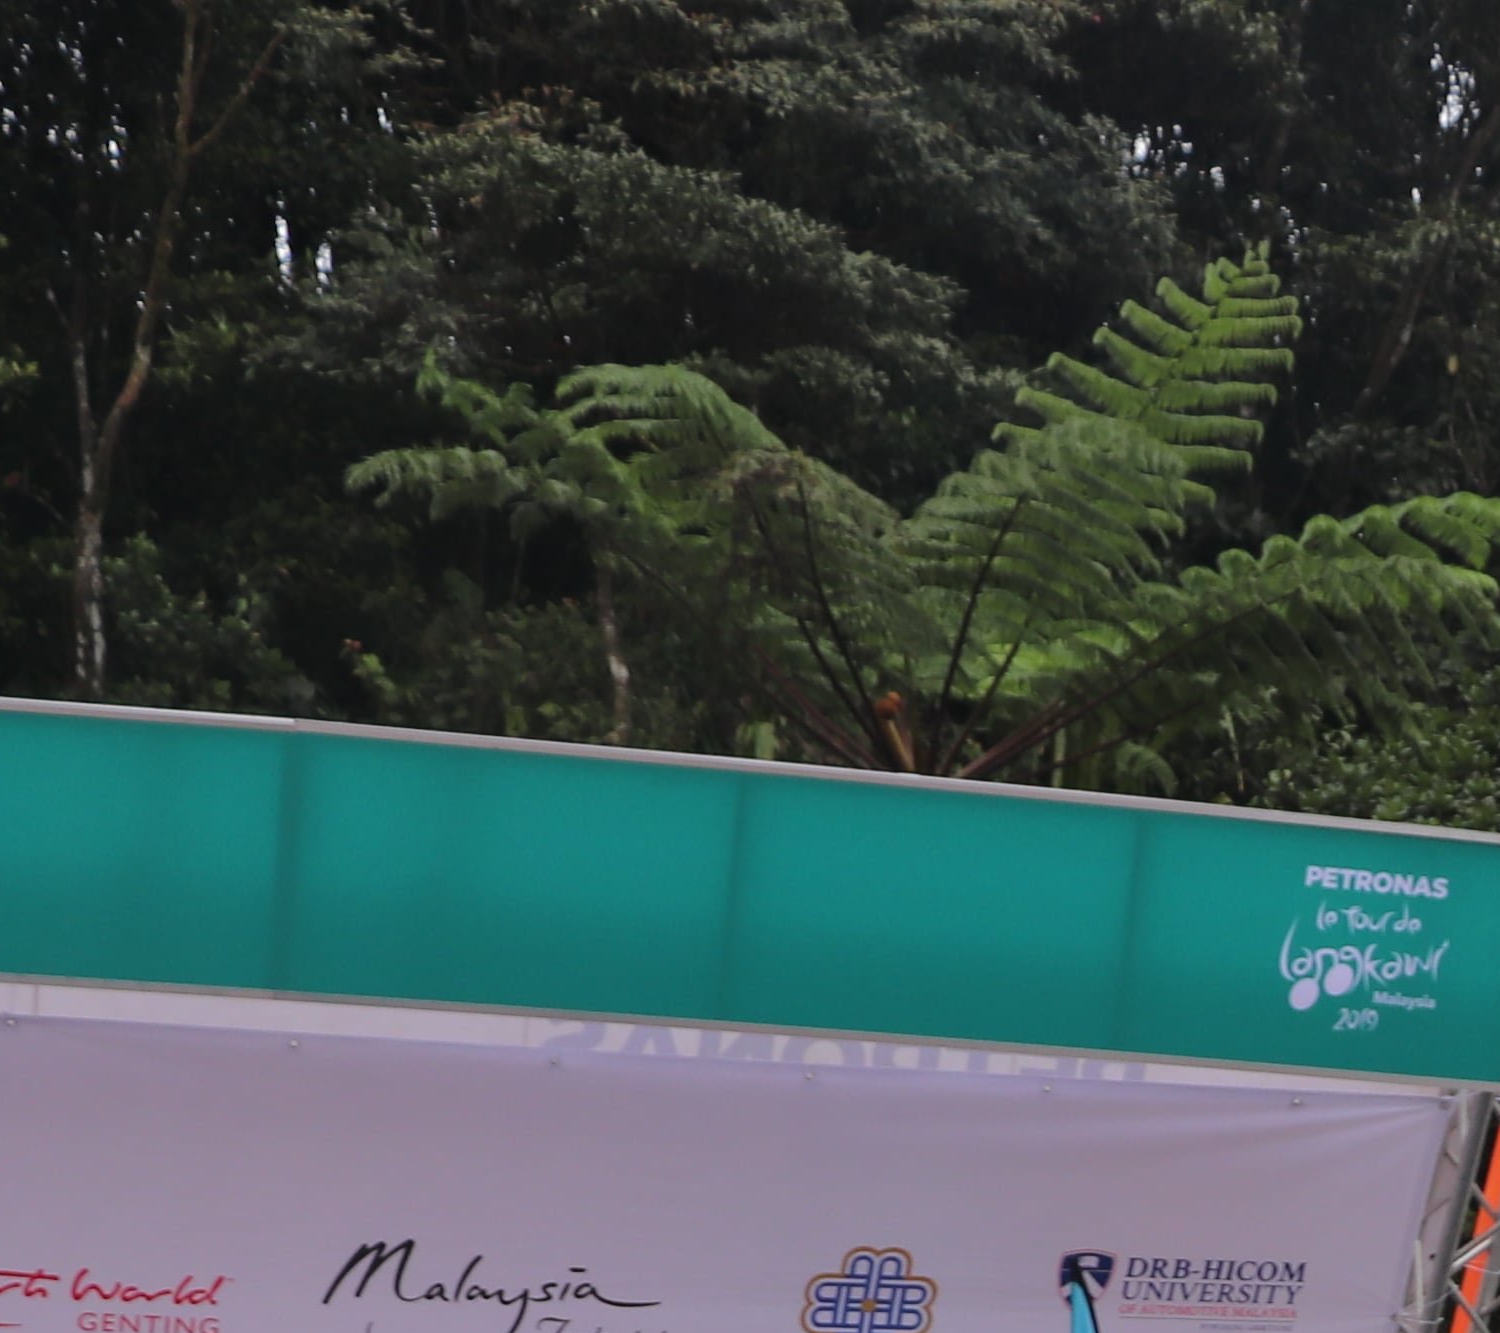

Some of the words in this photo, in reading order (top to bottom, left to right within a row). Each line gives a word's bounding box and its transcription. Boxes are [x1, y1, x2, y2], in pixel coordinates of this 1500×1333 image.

[1304, 865, 1449, 899] PETRONAS
[1124, 1256, 1308, 1284] DRB-HICOM
[1121, 1280, 1303, 1305] UNIVERSITY
